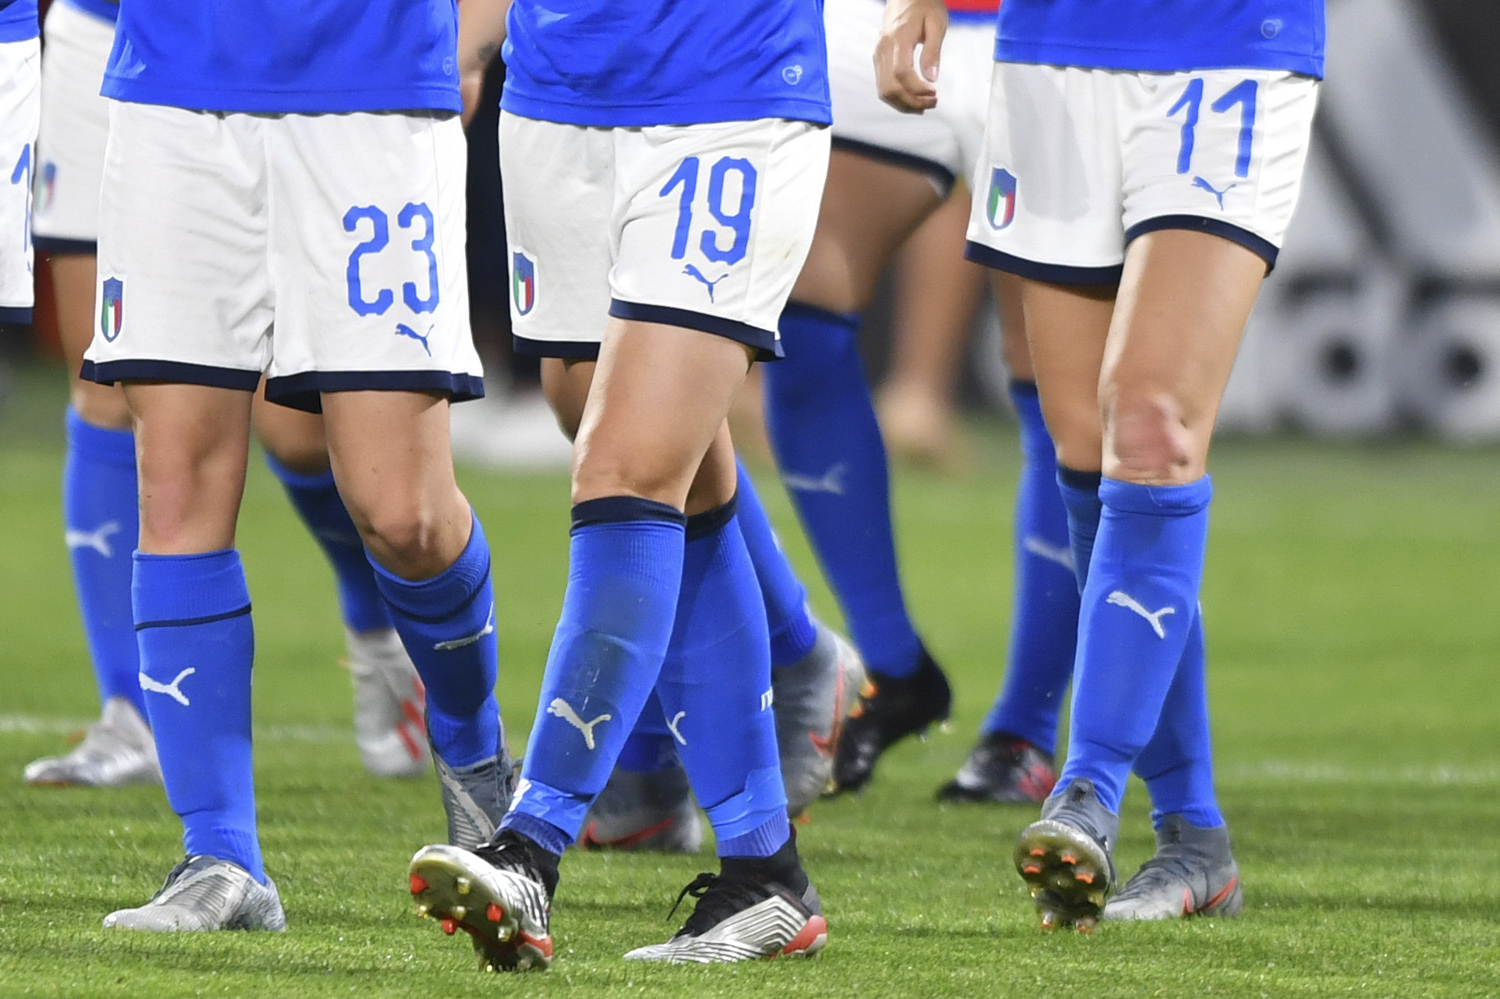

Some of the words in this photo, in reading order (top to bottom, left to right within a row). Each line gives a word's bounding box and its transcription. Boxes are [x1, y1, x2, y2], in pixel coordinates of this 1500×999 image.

[1168, 78, 1259, 178] 11
[342, 202, 440, 317] 23
[659, 157, 758, 266] 19
